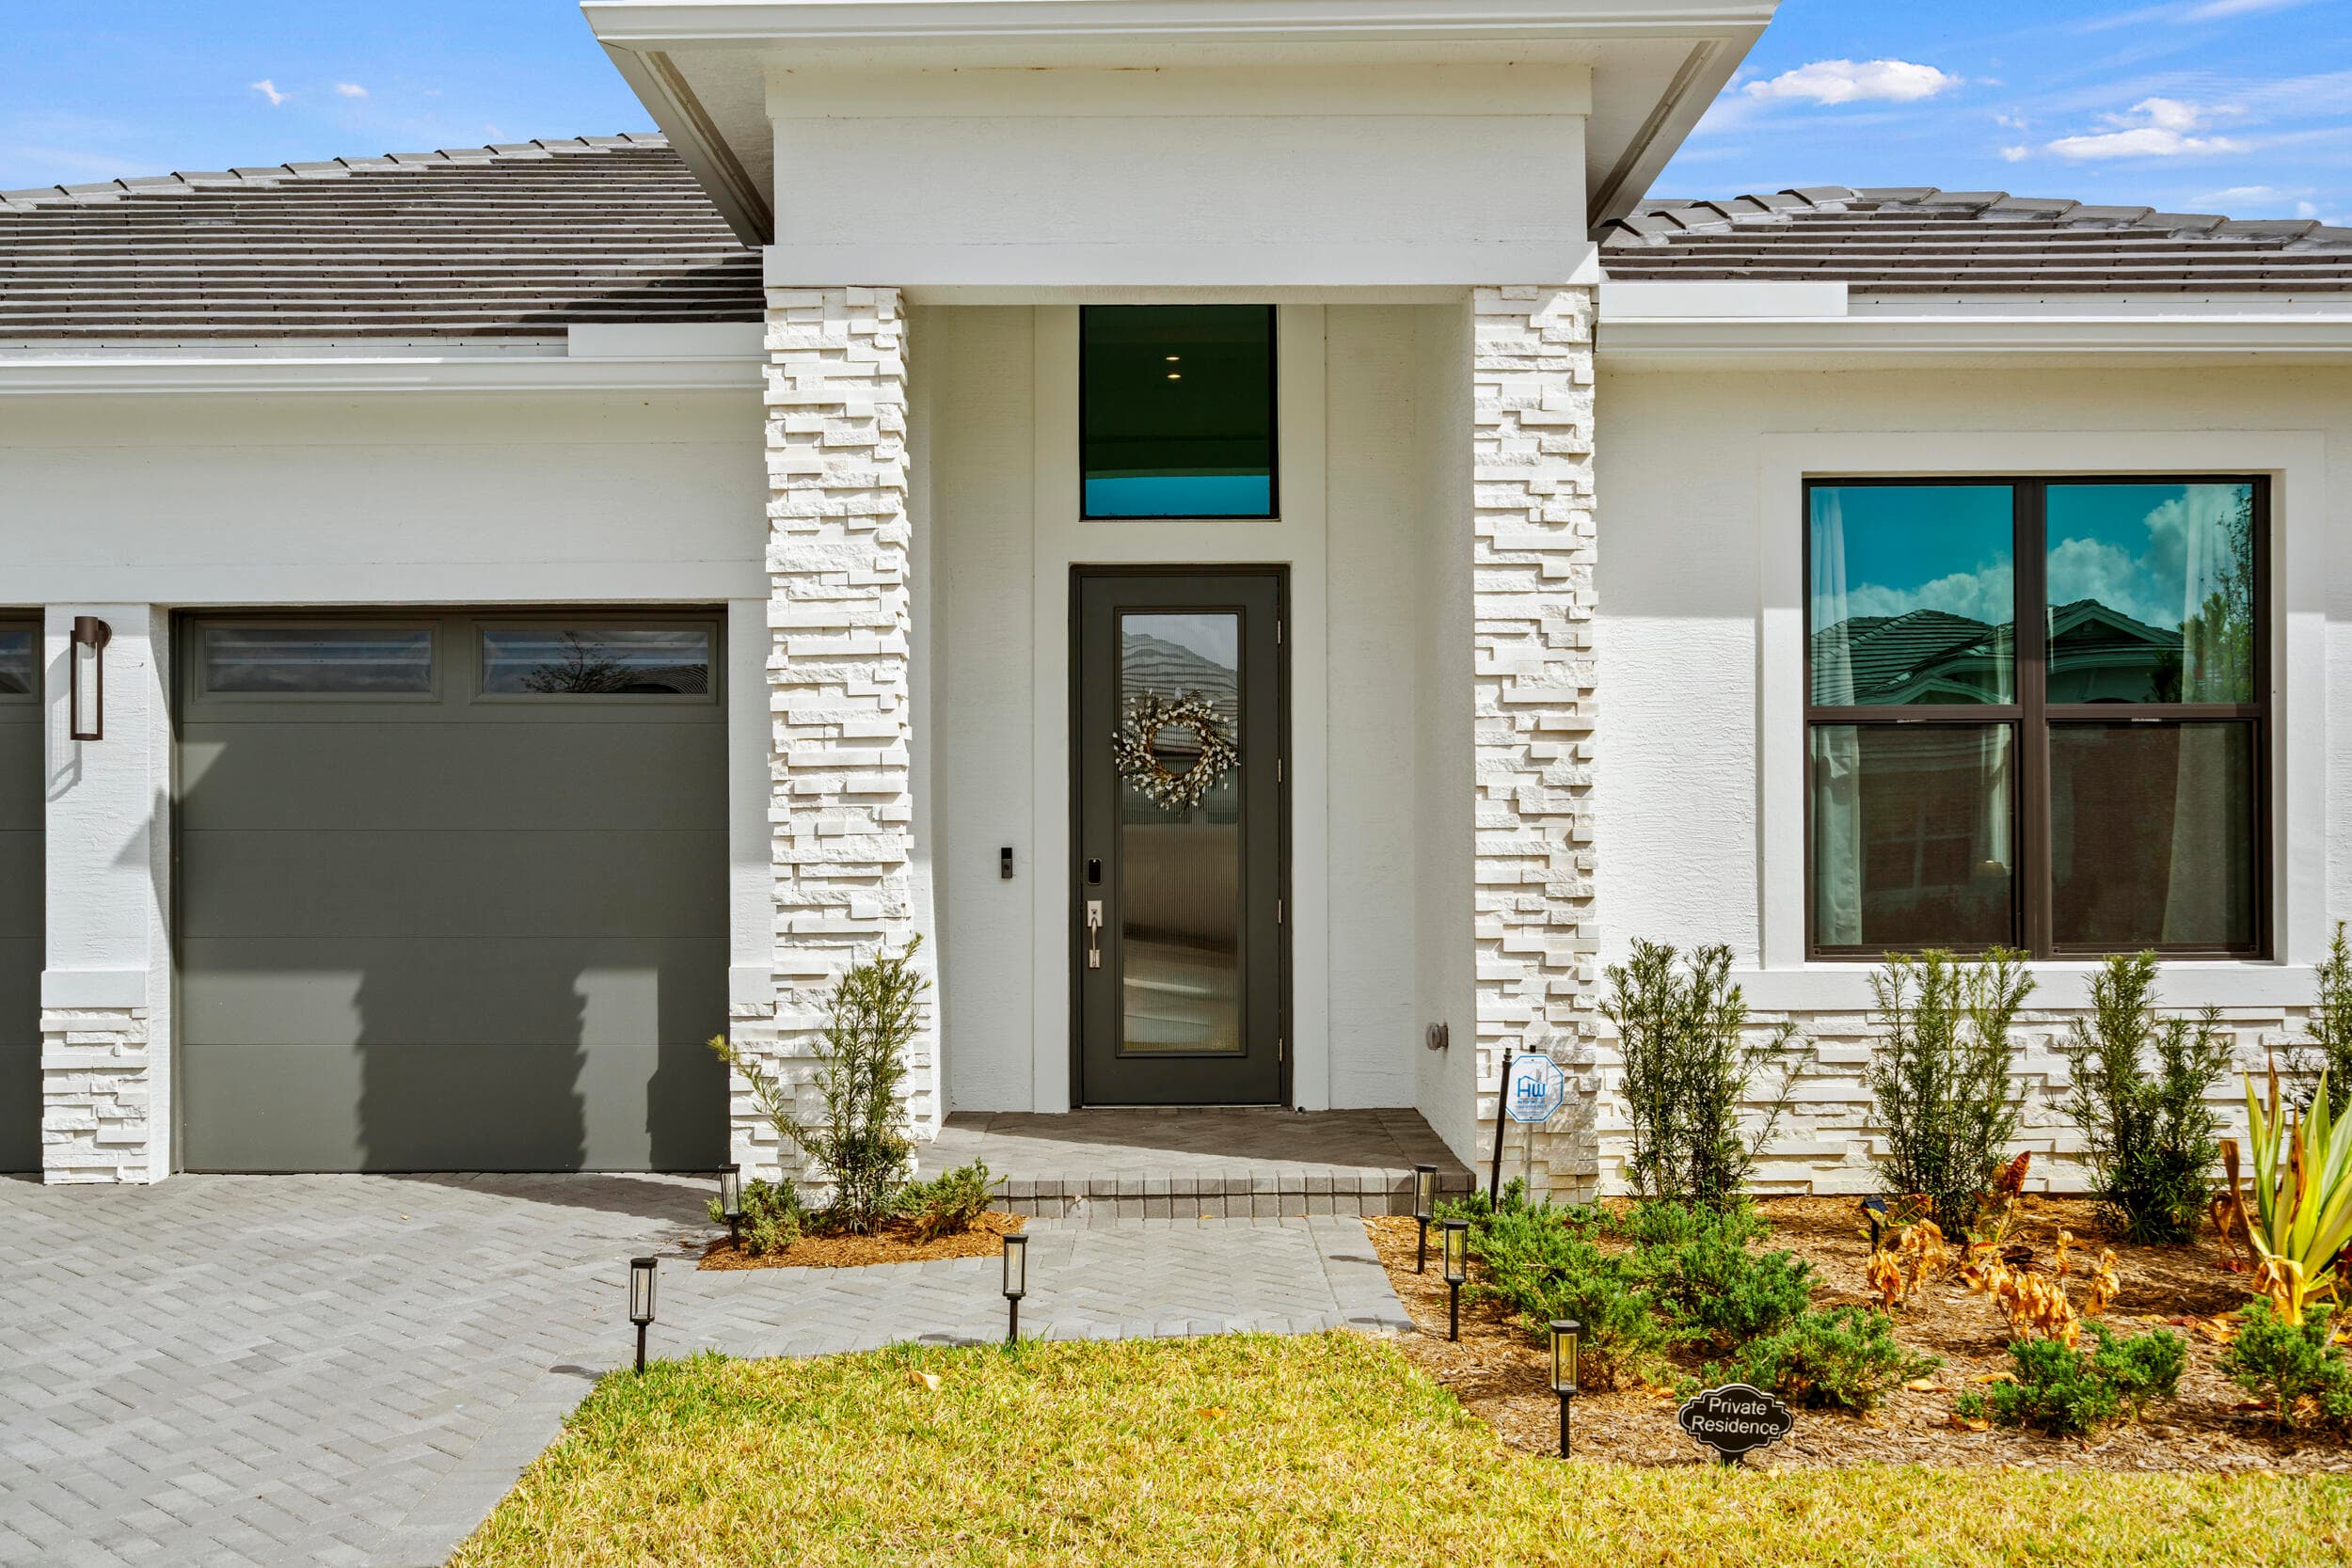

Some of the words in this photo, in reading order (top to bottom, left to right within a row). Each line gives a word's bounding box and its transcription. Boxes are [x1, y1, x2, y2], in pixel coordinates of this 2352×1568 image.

[1517, 1076, 1546, 1098] HW
[1708, 1397, 1767, 1416] Private
[1692, 1416, 1779, 1435] Residence
